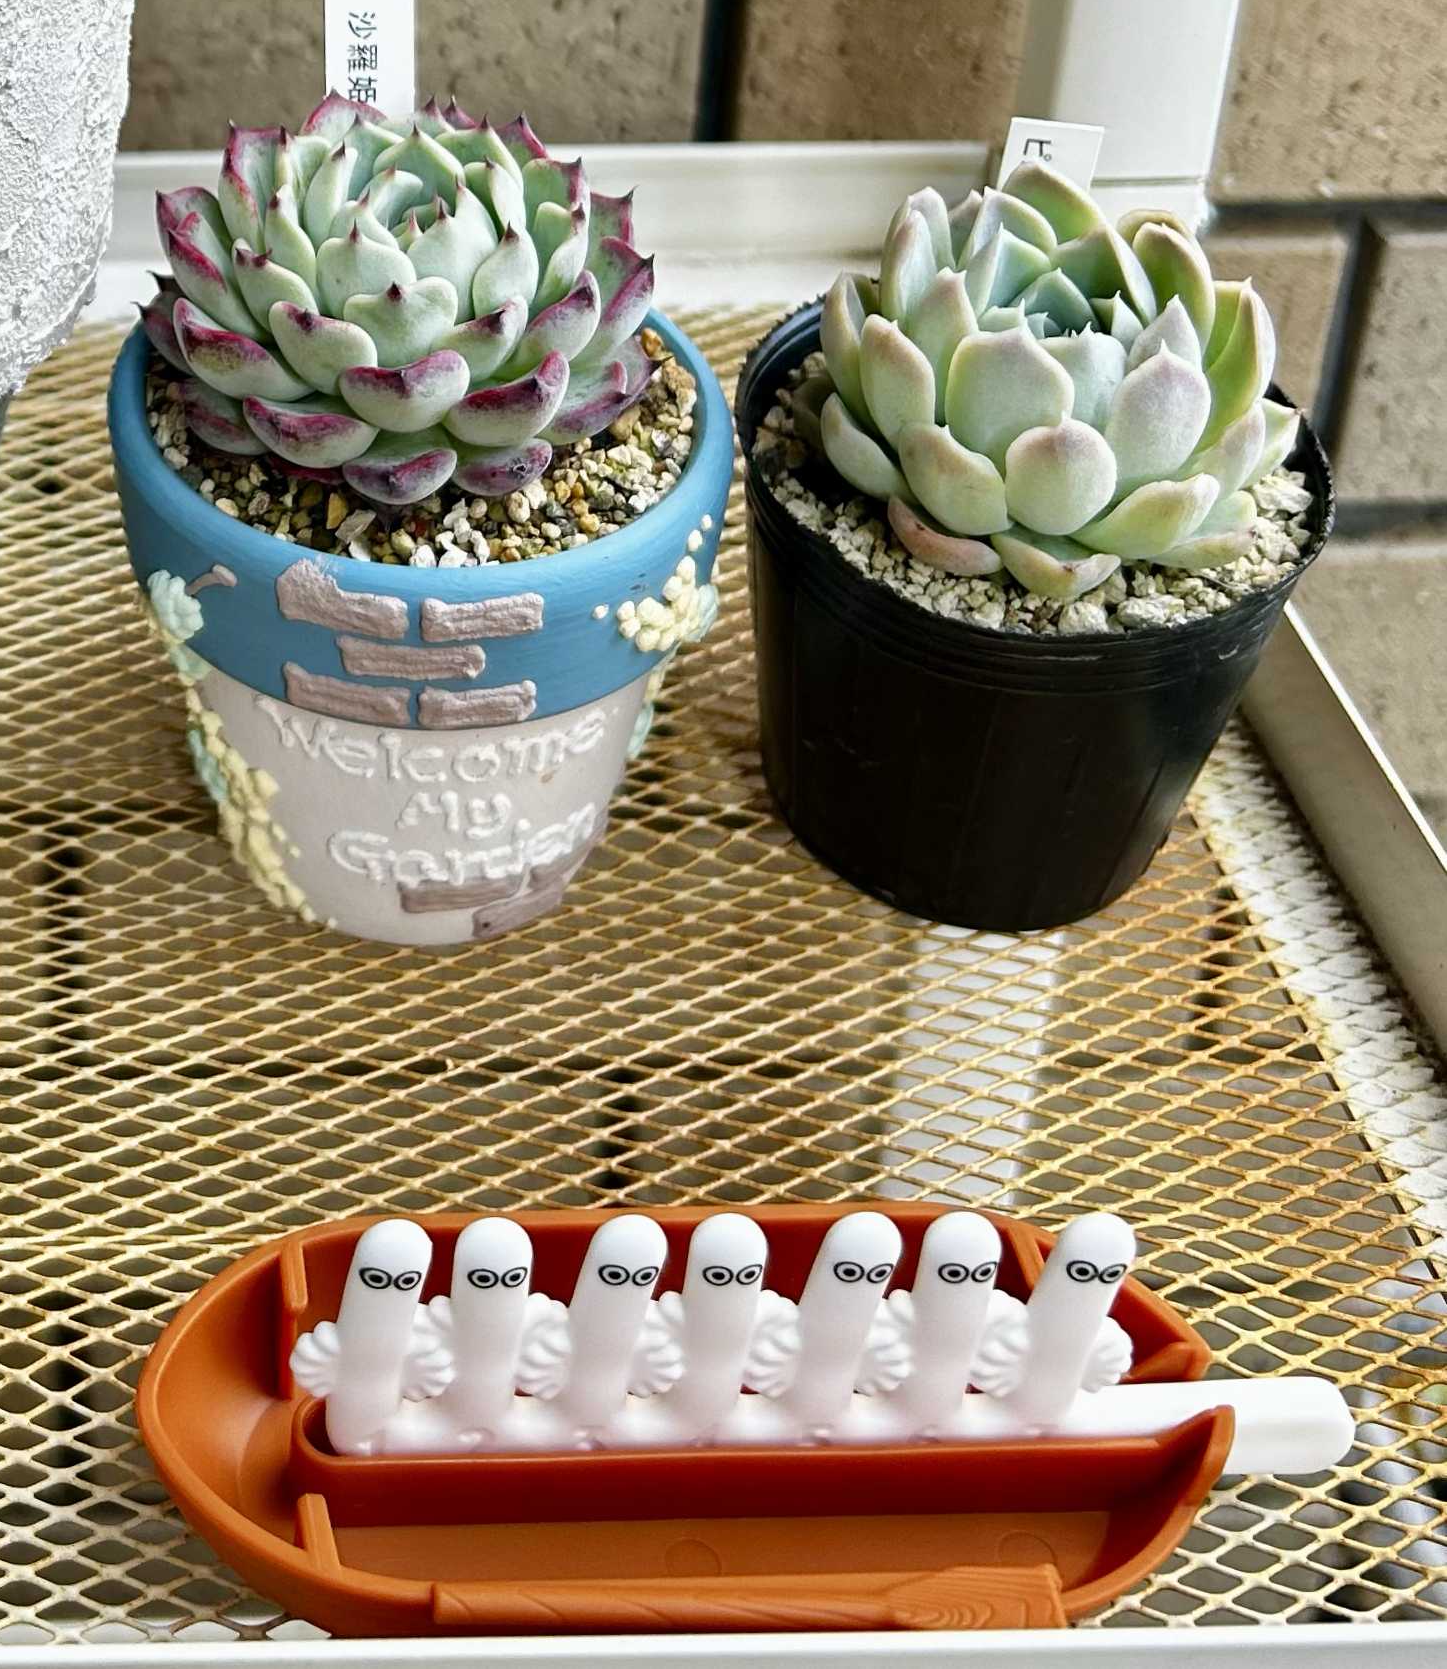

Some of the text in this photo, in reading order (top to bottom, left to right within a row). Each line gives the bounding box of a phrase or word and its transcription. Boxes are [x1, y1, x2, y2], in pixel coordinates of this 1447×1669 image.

[347, 10, 379, 104] 沙羅姫
[258, 695, 607, 783] Welcome
[328, 804, 596, 886] Garden
[398, 791, 512, 840] My
